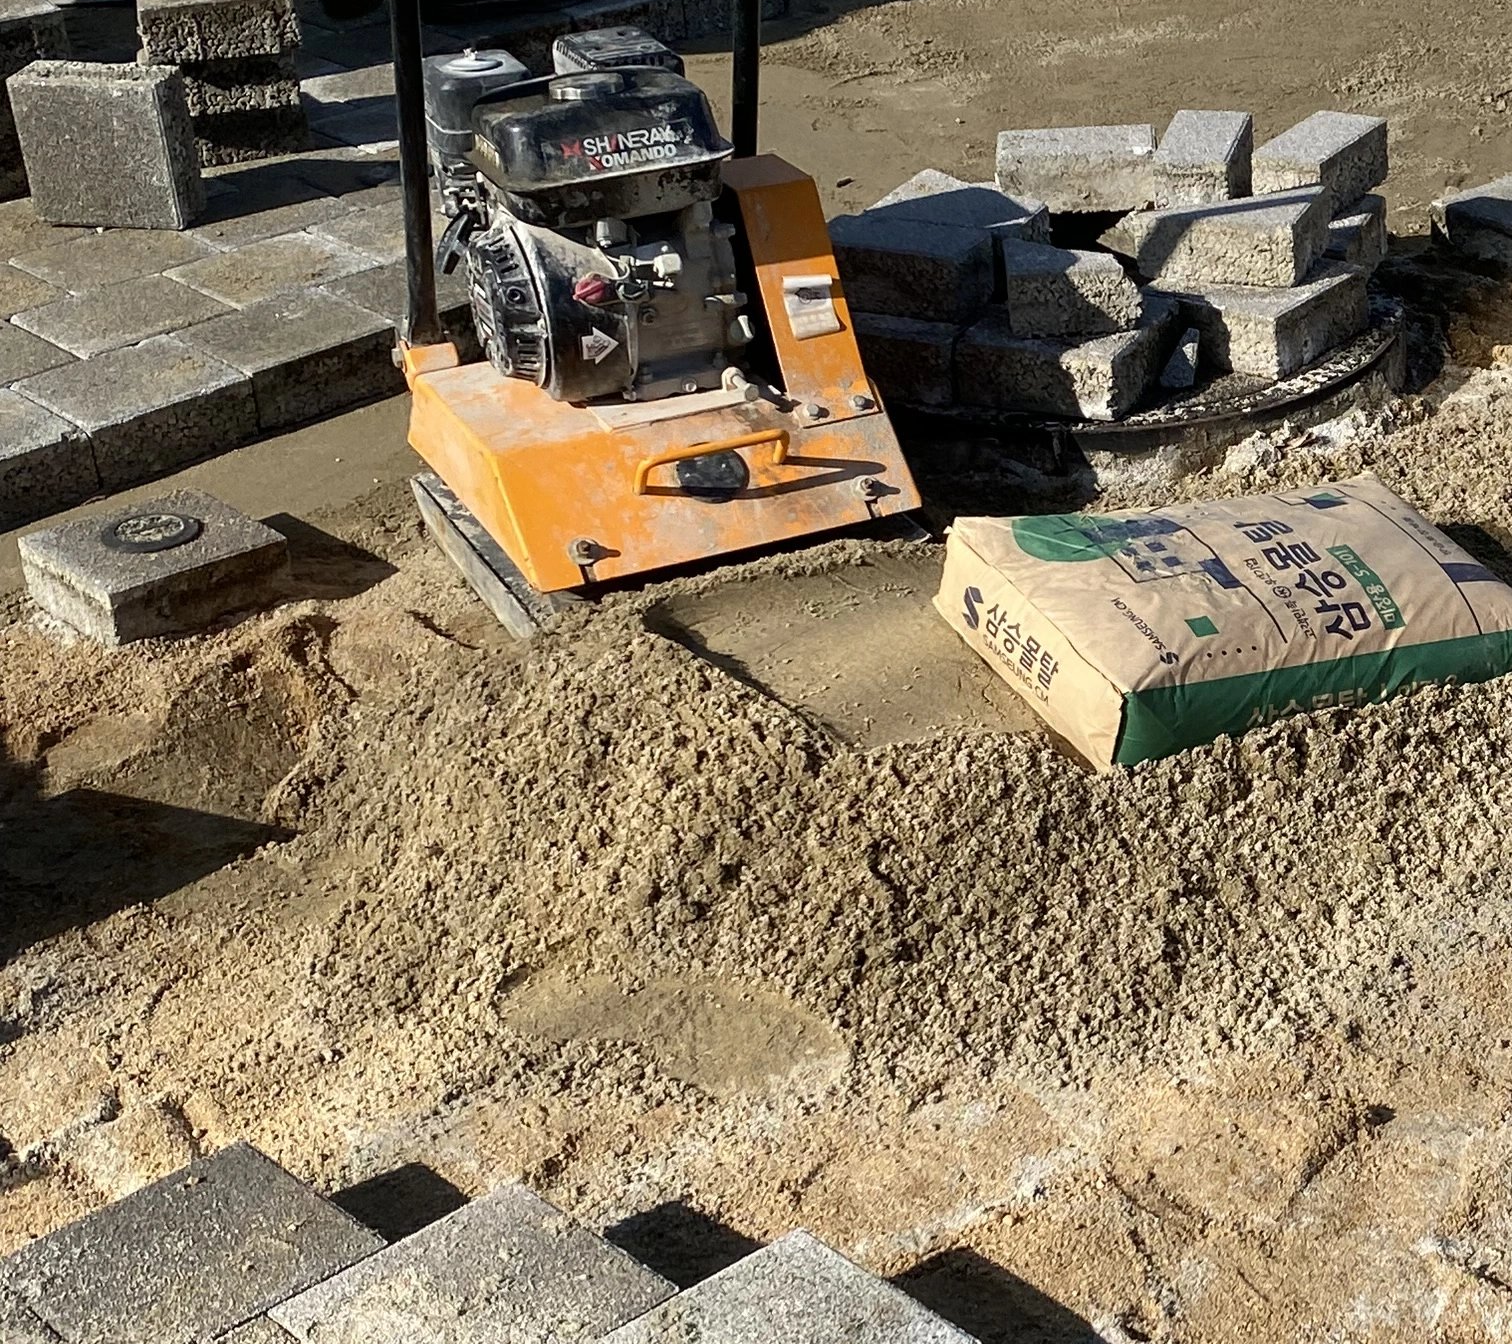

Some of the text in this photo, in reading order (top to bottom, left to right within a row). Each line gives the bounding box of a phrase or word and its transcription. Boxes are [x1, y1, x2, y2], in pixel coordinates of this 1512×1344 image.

[1233, 519, 1372, 641] 삼승몰탈
[1335, 547, 1396, 623] 미장용 S-101
[985, 603, 1059, 690] 삼승몰탈
